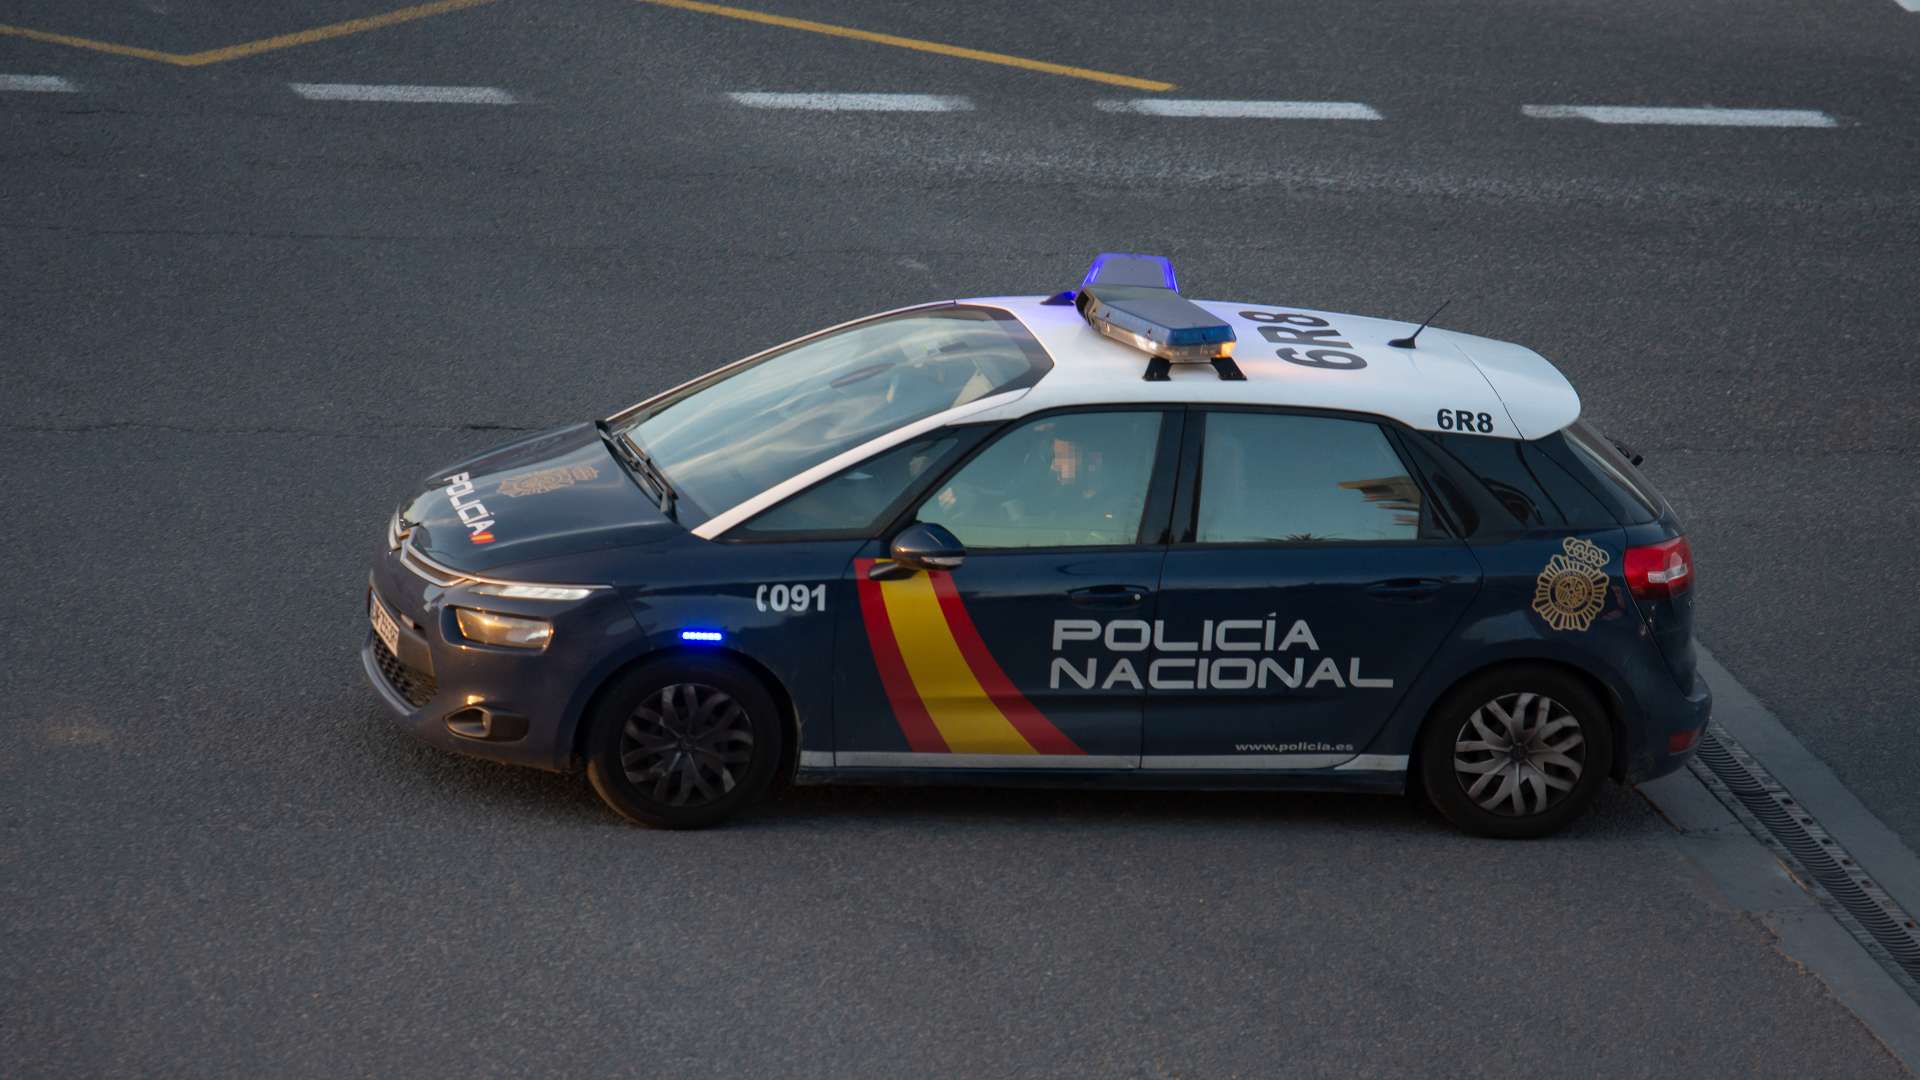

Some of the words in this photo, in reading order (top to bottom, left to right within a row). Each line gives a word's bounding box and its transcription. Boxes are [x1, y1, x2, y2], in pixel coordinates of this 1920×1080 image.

[1238, 310, 1368, 370] 6R8
[1437, 408, 1494, 433] 6R8
[443, 471, 496, 536] POLICÍA
[770, 584, 826, 612] 091
[1052, 612, 1320, 651] POLICÍA
[1050, 657, 1394, 690] NACIONAL
[1235, 741, 1354, 752] www.policia.es
